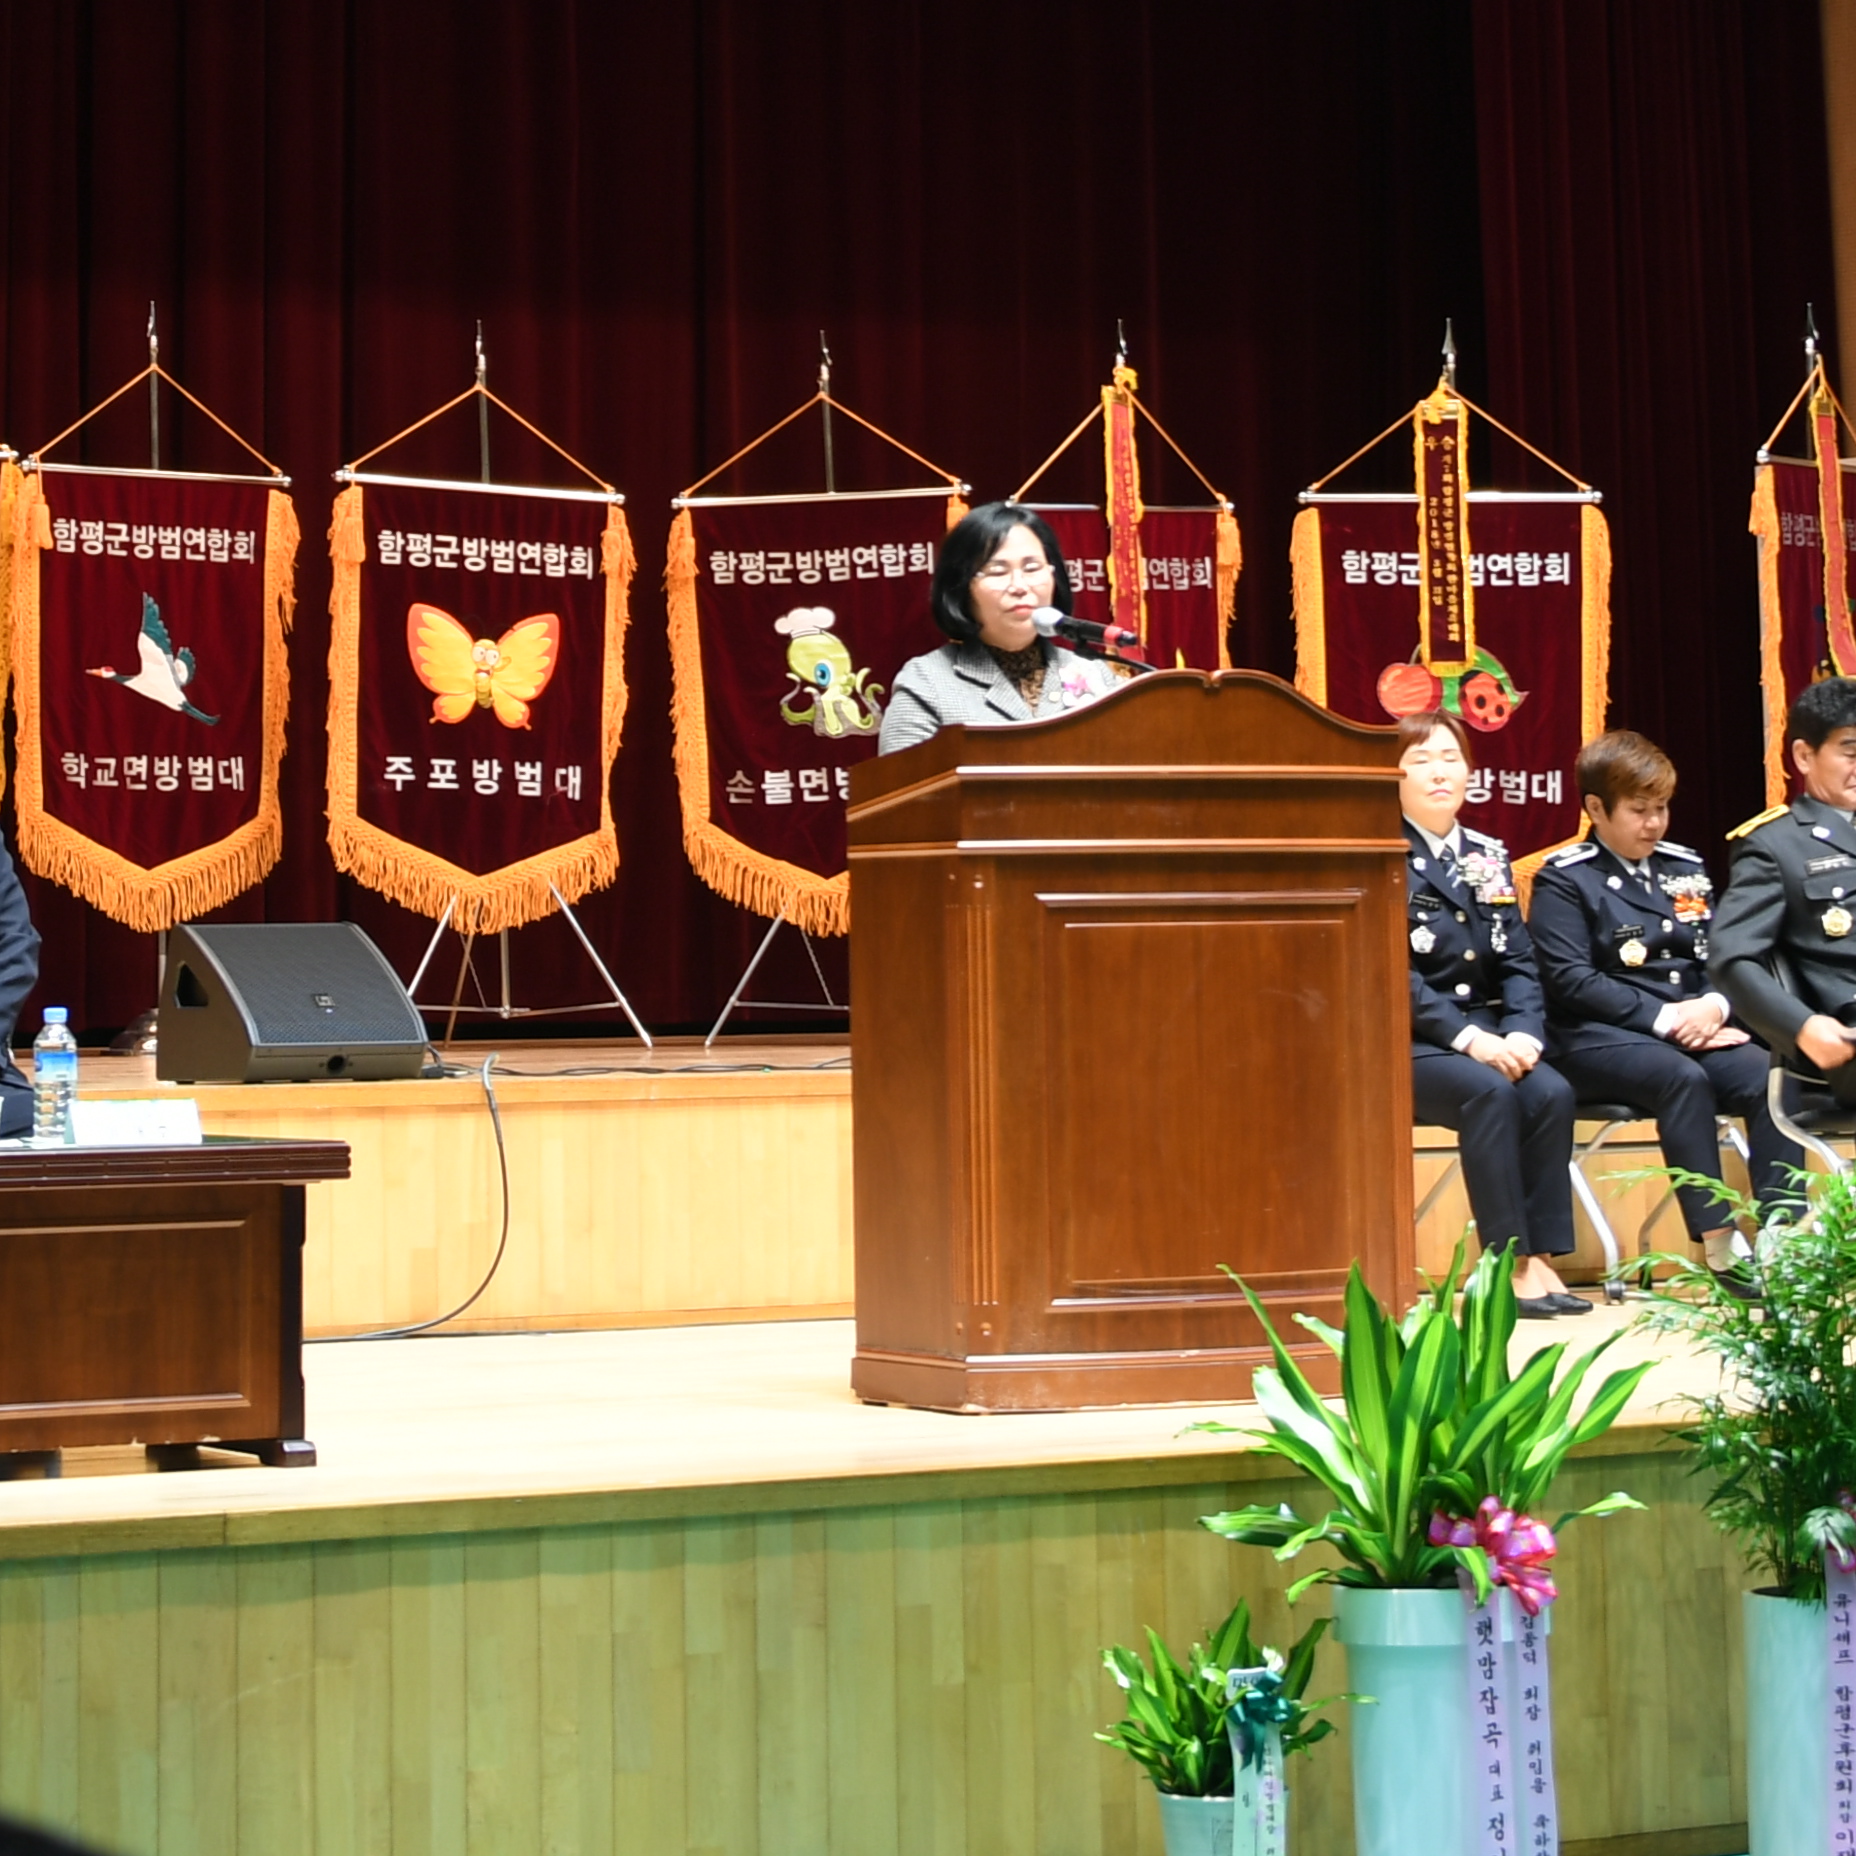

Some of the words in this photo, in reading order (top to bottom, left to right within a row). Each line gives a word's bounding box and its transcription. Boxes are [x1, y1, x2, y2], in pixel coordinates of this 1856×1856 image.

[52, 517, 256, 564] 함평군방범연합회
[377, 529, 595, 580] 함평군방범연합회
[709, 541, 935, 585] 함평군방범연합회
[1063, 556, 1213, 592] 평군연합회
[1340, 549, 1571, 587] 함평군범연합회
[60, 752, 245, 792] 학교면방범대
